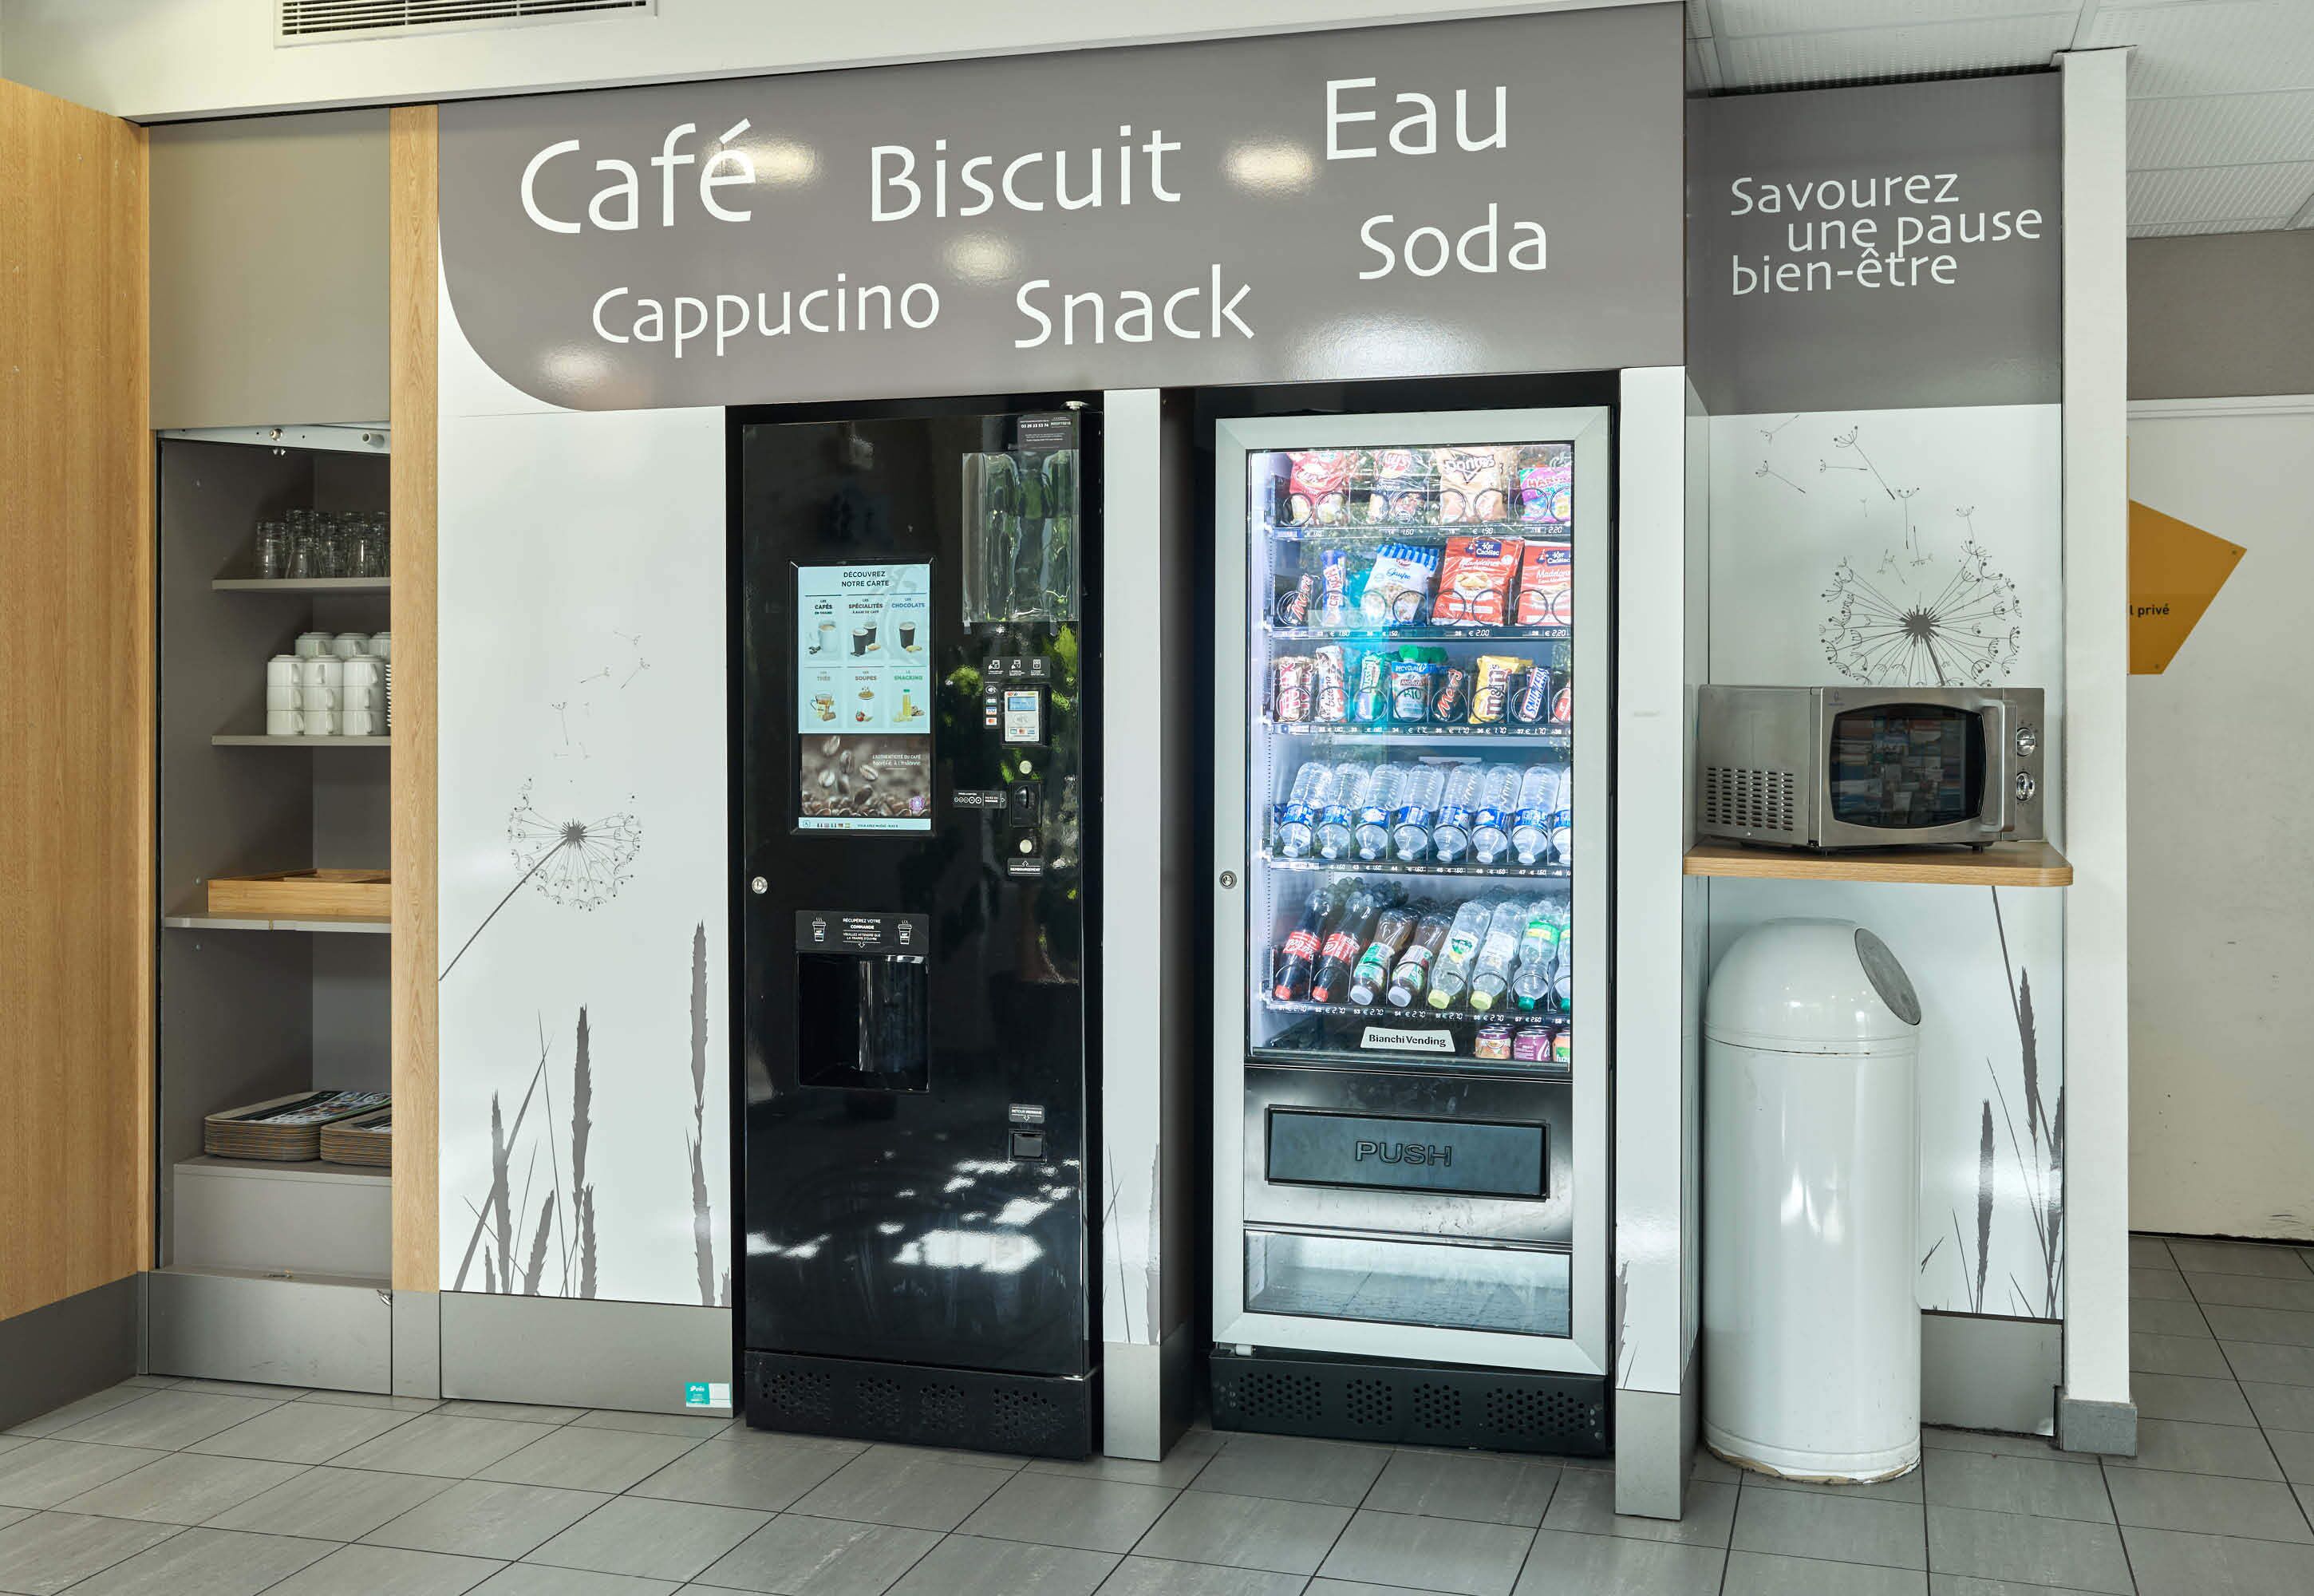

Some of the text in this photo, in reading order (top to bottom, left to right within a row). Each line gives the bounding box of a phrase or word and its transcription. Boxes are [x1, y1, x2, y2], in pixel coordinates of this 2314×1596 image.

[1326, 77, 1507, 160] Eau
[519, 117, 757, 235] Café
[871, 124, 1182, 222] Biscuit
[1731, 173, 1959, 215] Savourez
[1359, 202, 1547, 280] Soda
[1788, 209, 2043, 258] une pause
[1732, 247, 1957, 296] bien-être
[592, 272, 940, 358] Cappucino
[1014, 263, 1255, 349] Snack
[1482, 542, 1494, 551] Ker
[843, 570, 886, 579] DÉCOUVREZ
[2138, 602, 2170, 618] privé
[1526, 667, 1550, 715] SNICKERS
[1412, 1009, 1426, 1018] 2.70
[1368, 1034, 1447, 1048] Bianchi Vending
[1356, 1140, 1452, 1167] PUSH
